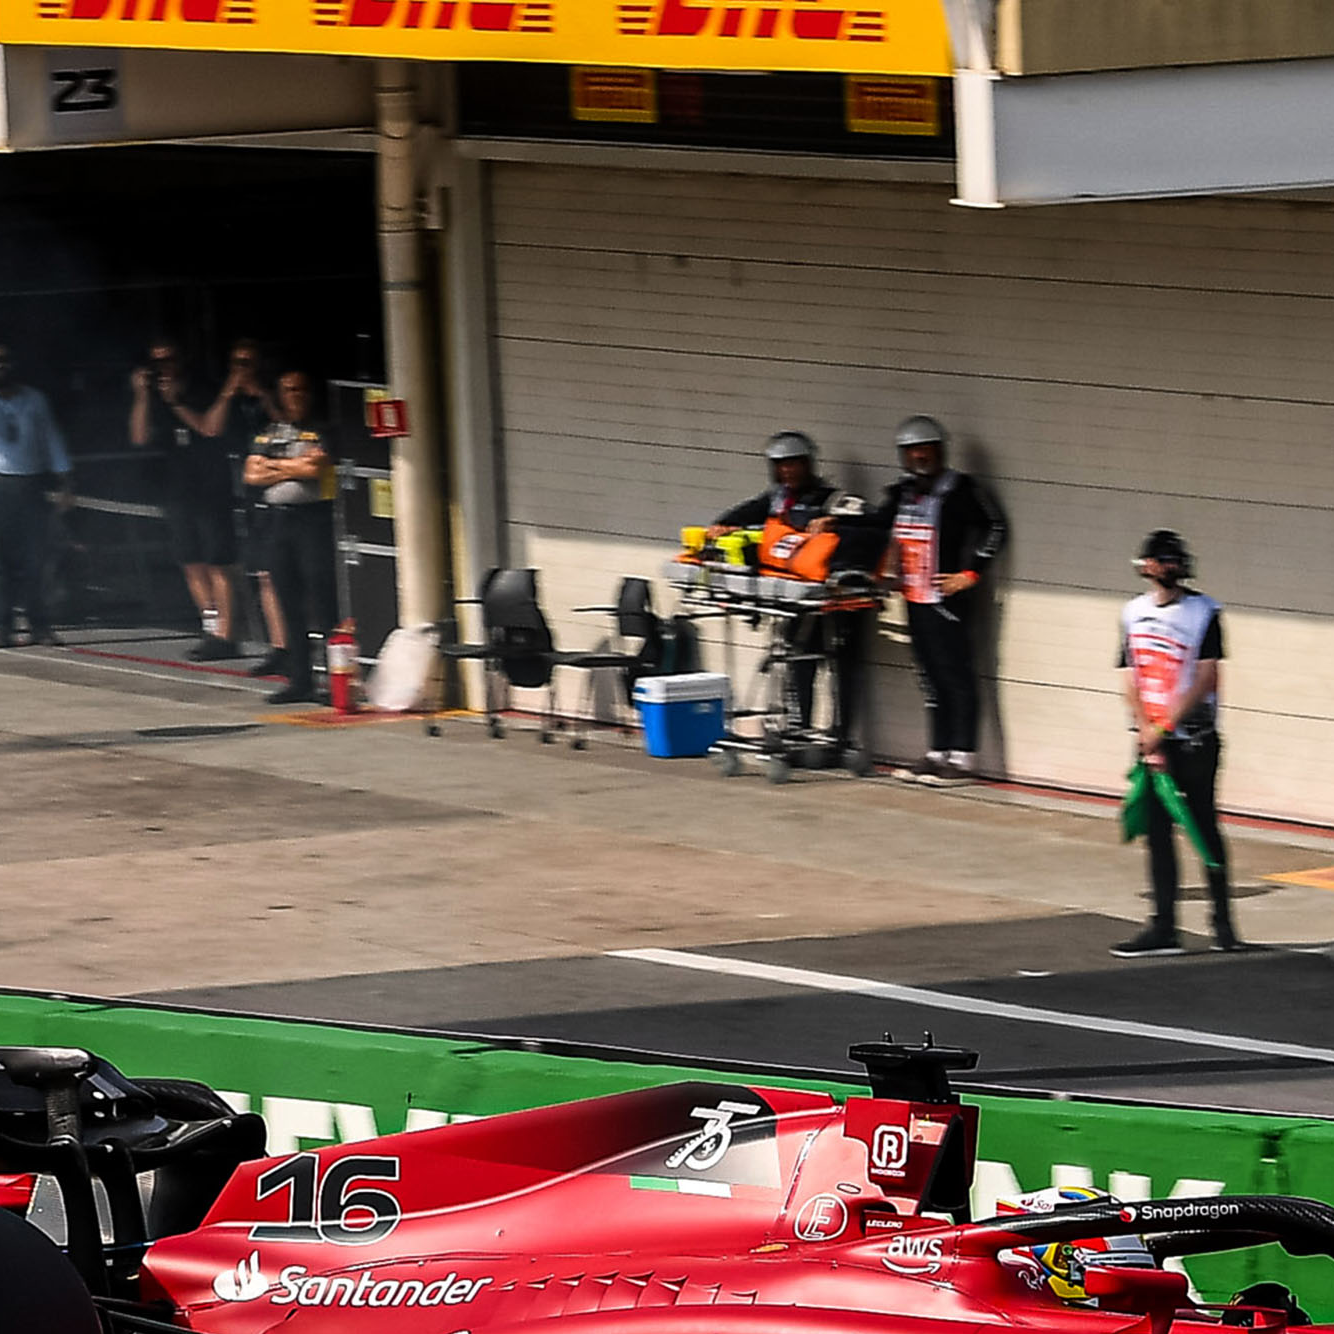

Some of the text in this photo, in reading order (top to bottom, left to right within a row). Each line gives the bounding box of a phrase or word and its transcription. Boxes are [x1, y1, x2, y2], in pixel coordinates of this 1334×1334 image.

[51, 68, 117, 112] 23
[248, 1151, 402, 1245] 16
[1141, 1203, 1239, 1221] Snapdragon
[888, 1236, 943, 1261] aws
[271, 1265, 493, 1307] Santander
